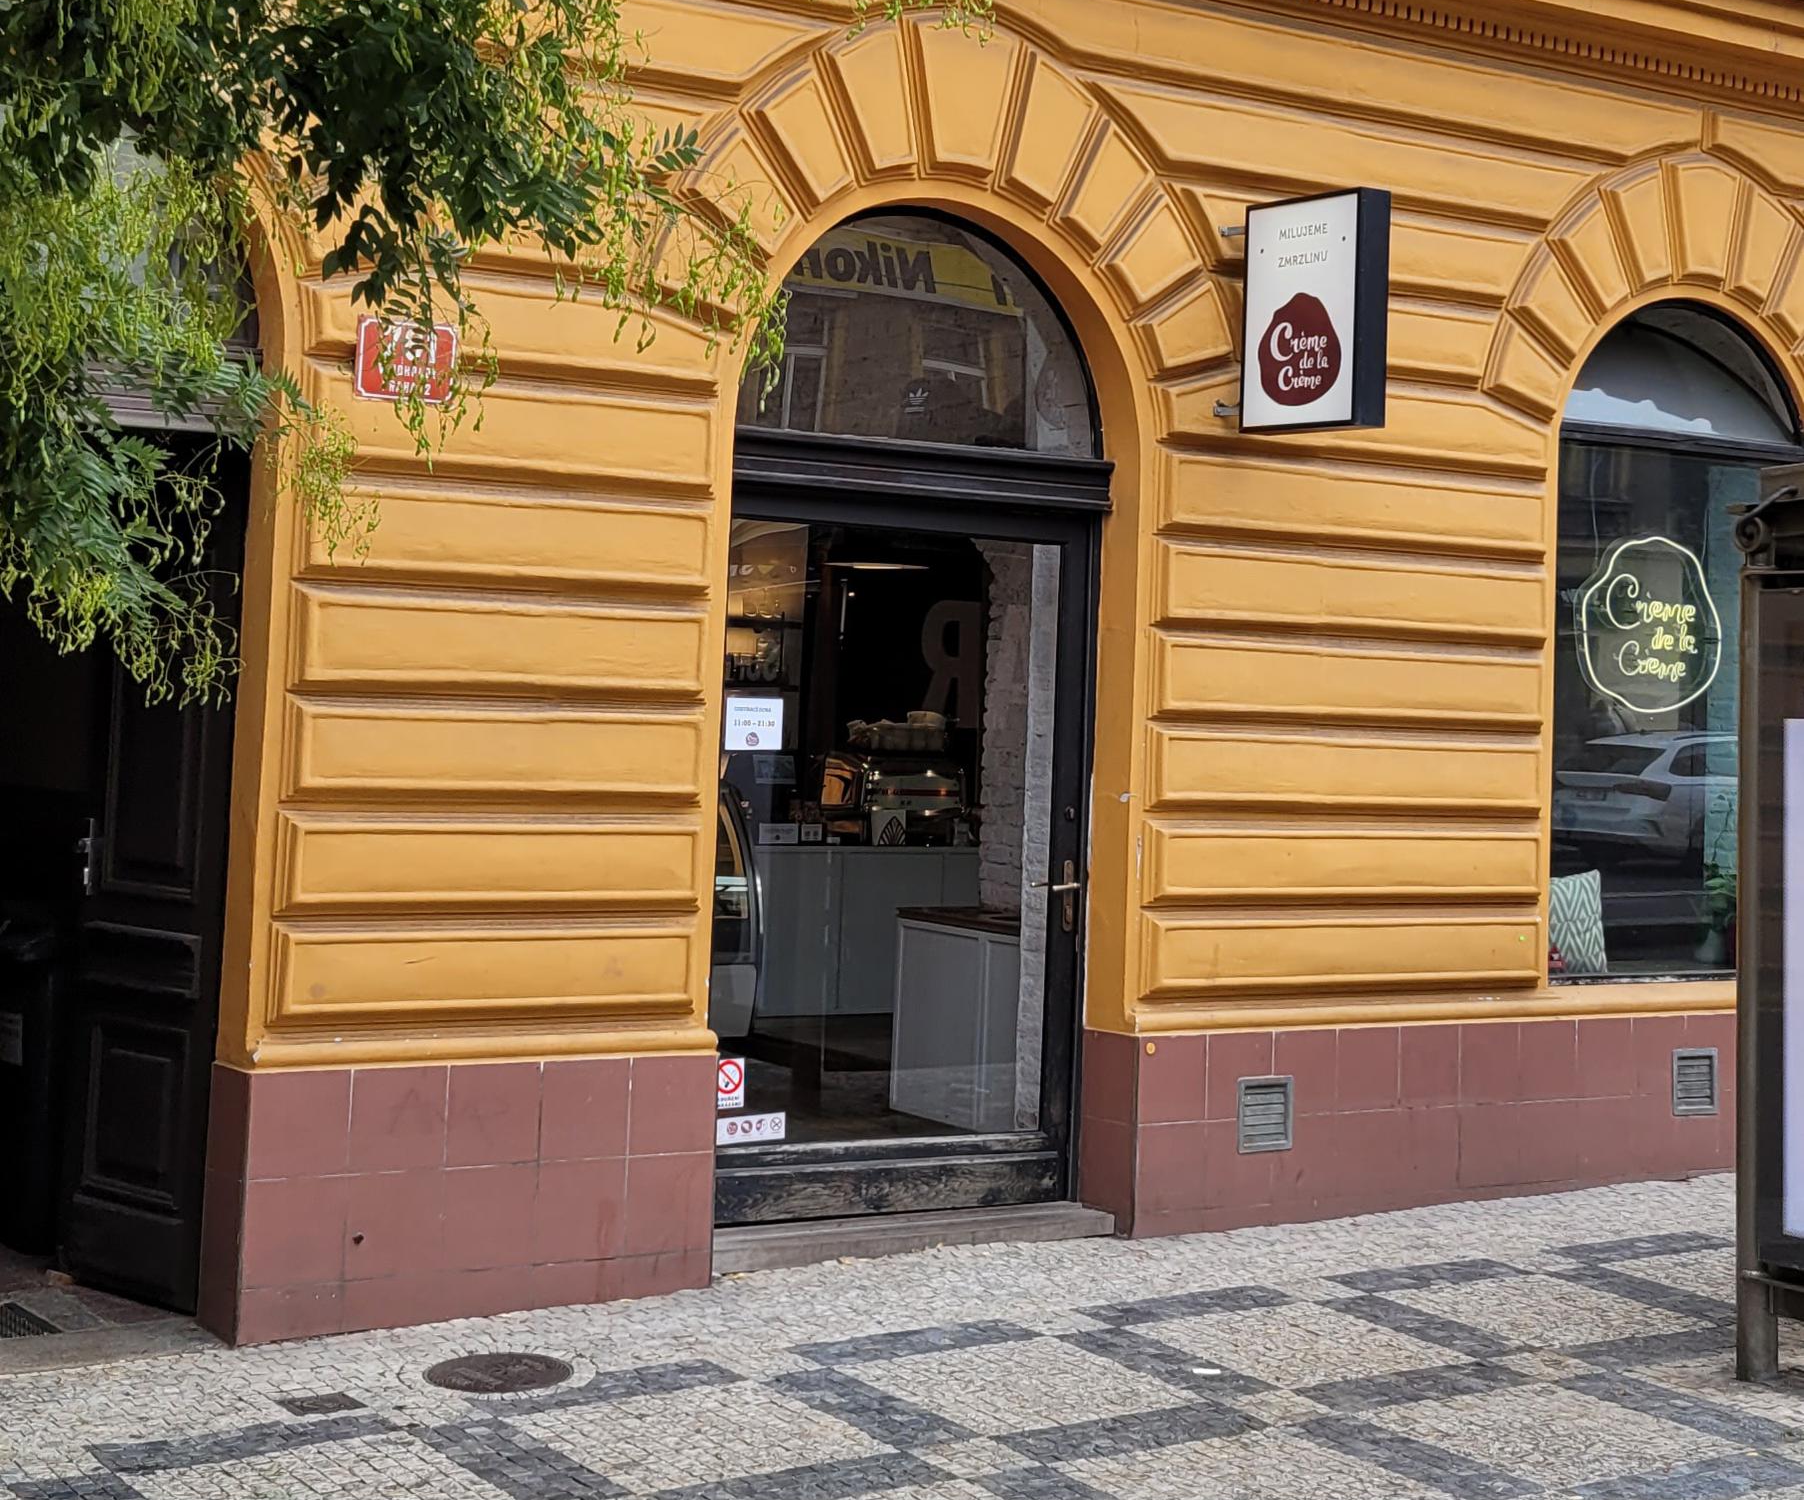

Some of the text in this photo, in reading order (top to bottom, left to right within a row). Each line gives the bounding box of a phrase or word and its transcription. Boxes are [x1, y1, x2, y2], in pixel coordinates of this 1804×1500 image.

[1279, 223, 1328, 240] MILUJEME
[1278, 250, 1329, 268] ZMRZLINU
[1270, 321, 1328, 362] Crème
[1299, 349, 1329, 370] de la
[424, 383, 432, 396] 2
[1278, 365, 1322, 391] Crème
[1606, 573, 1697, 630] Crème
[1651, 623, 1698, 654] de la
[1618, 640, 1687, 683] Crème
